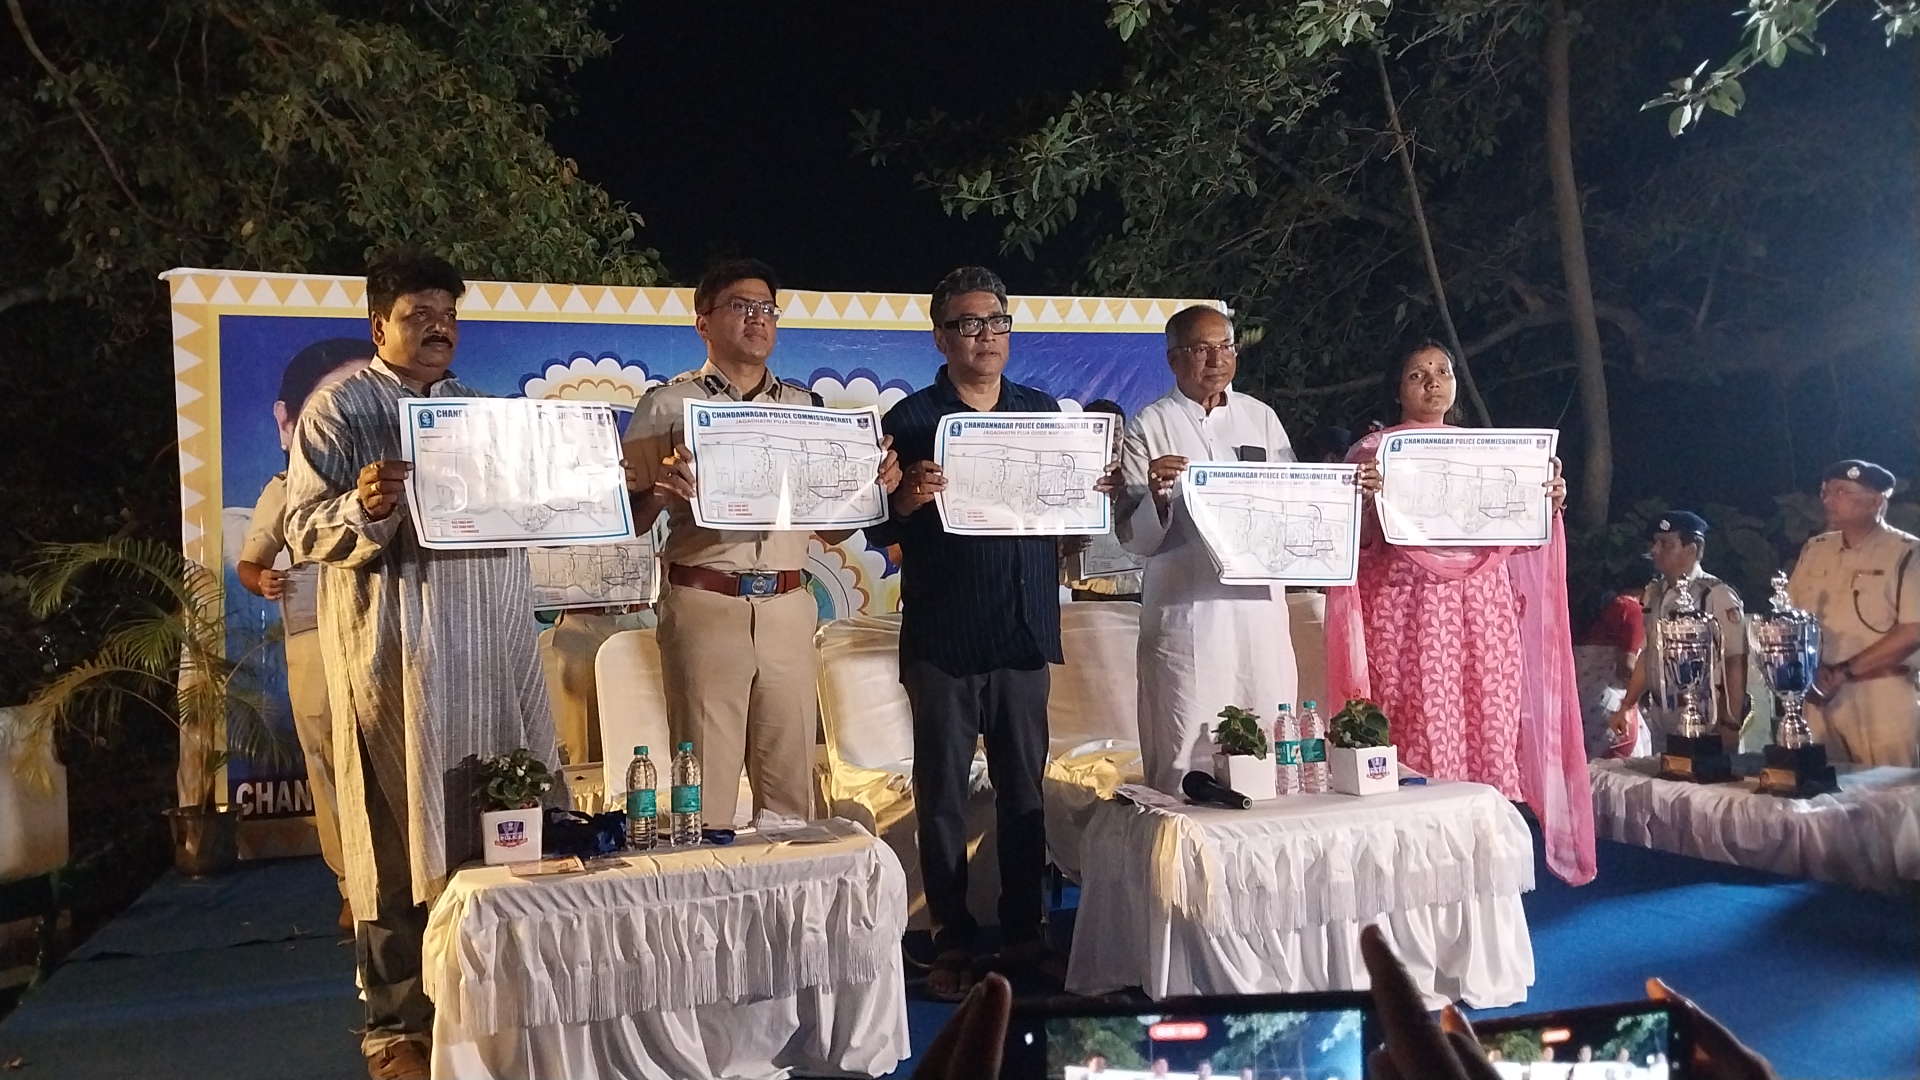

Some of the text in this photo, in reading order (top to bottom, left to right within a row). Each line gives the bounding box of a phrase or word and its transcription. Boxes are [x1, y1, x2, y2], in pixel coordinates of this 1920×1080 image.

[711, 411, 853, 424] CHANDANNAGAR POLICE COMMISSIONERATE
[1208, 471, 1258, 479] CHANDANNAGAR
